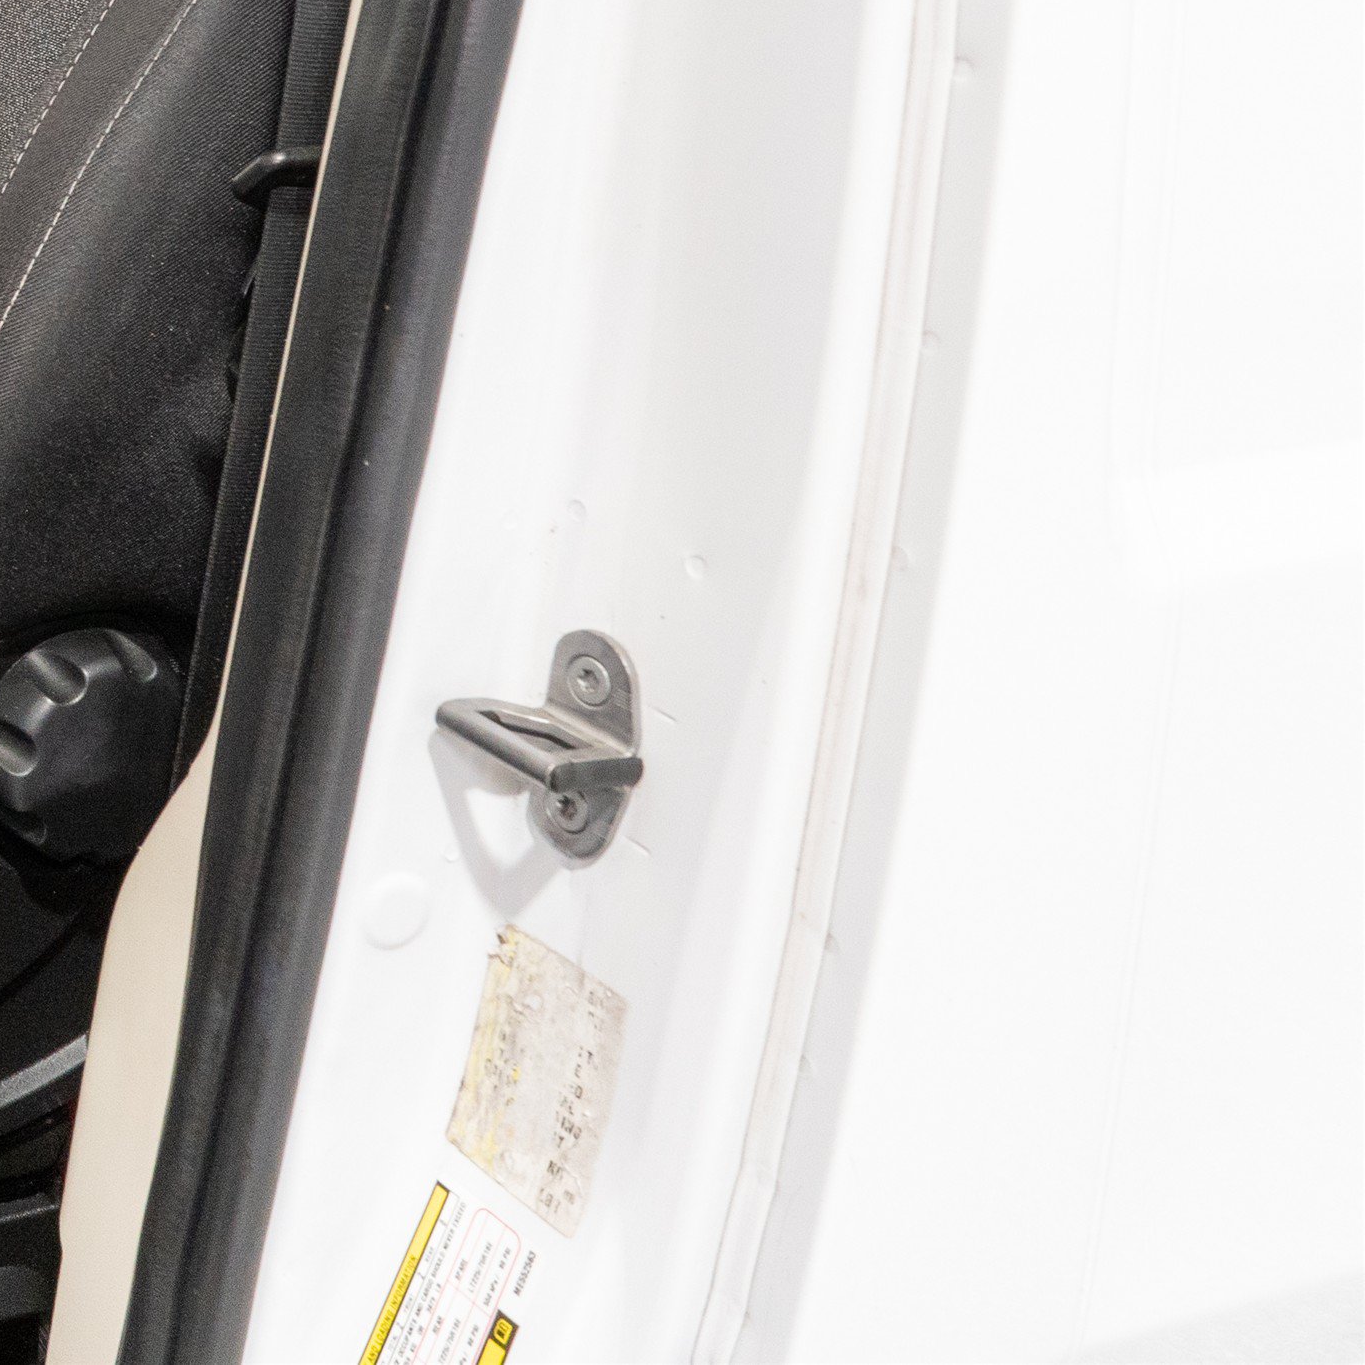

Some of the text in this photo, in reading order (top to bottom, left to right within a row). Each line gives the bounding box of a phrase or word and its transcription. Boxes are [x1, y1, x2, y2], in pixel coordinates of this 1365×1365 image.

[442, 1227, 455, 1250] NEVER
[374, 1308, 395, 1346] LOADING
[389, 1253, 418, 1310] INFORMATION
[431, 1314, 444, 1335] REAR
